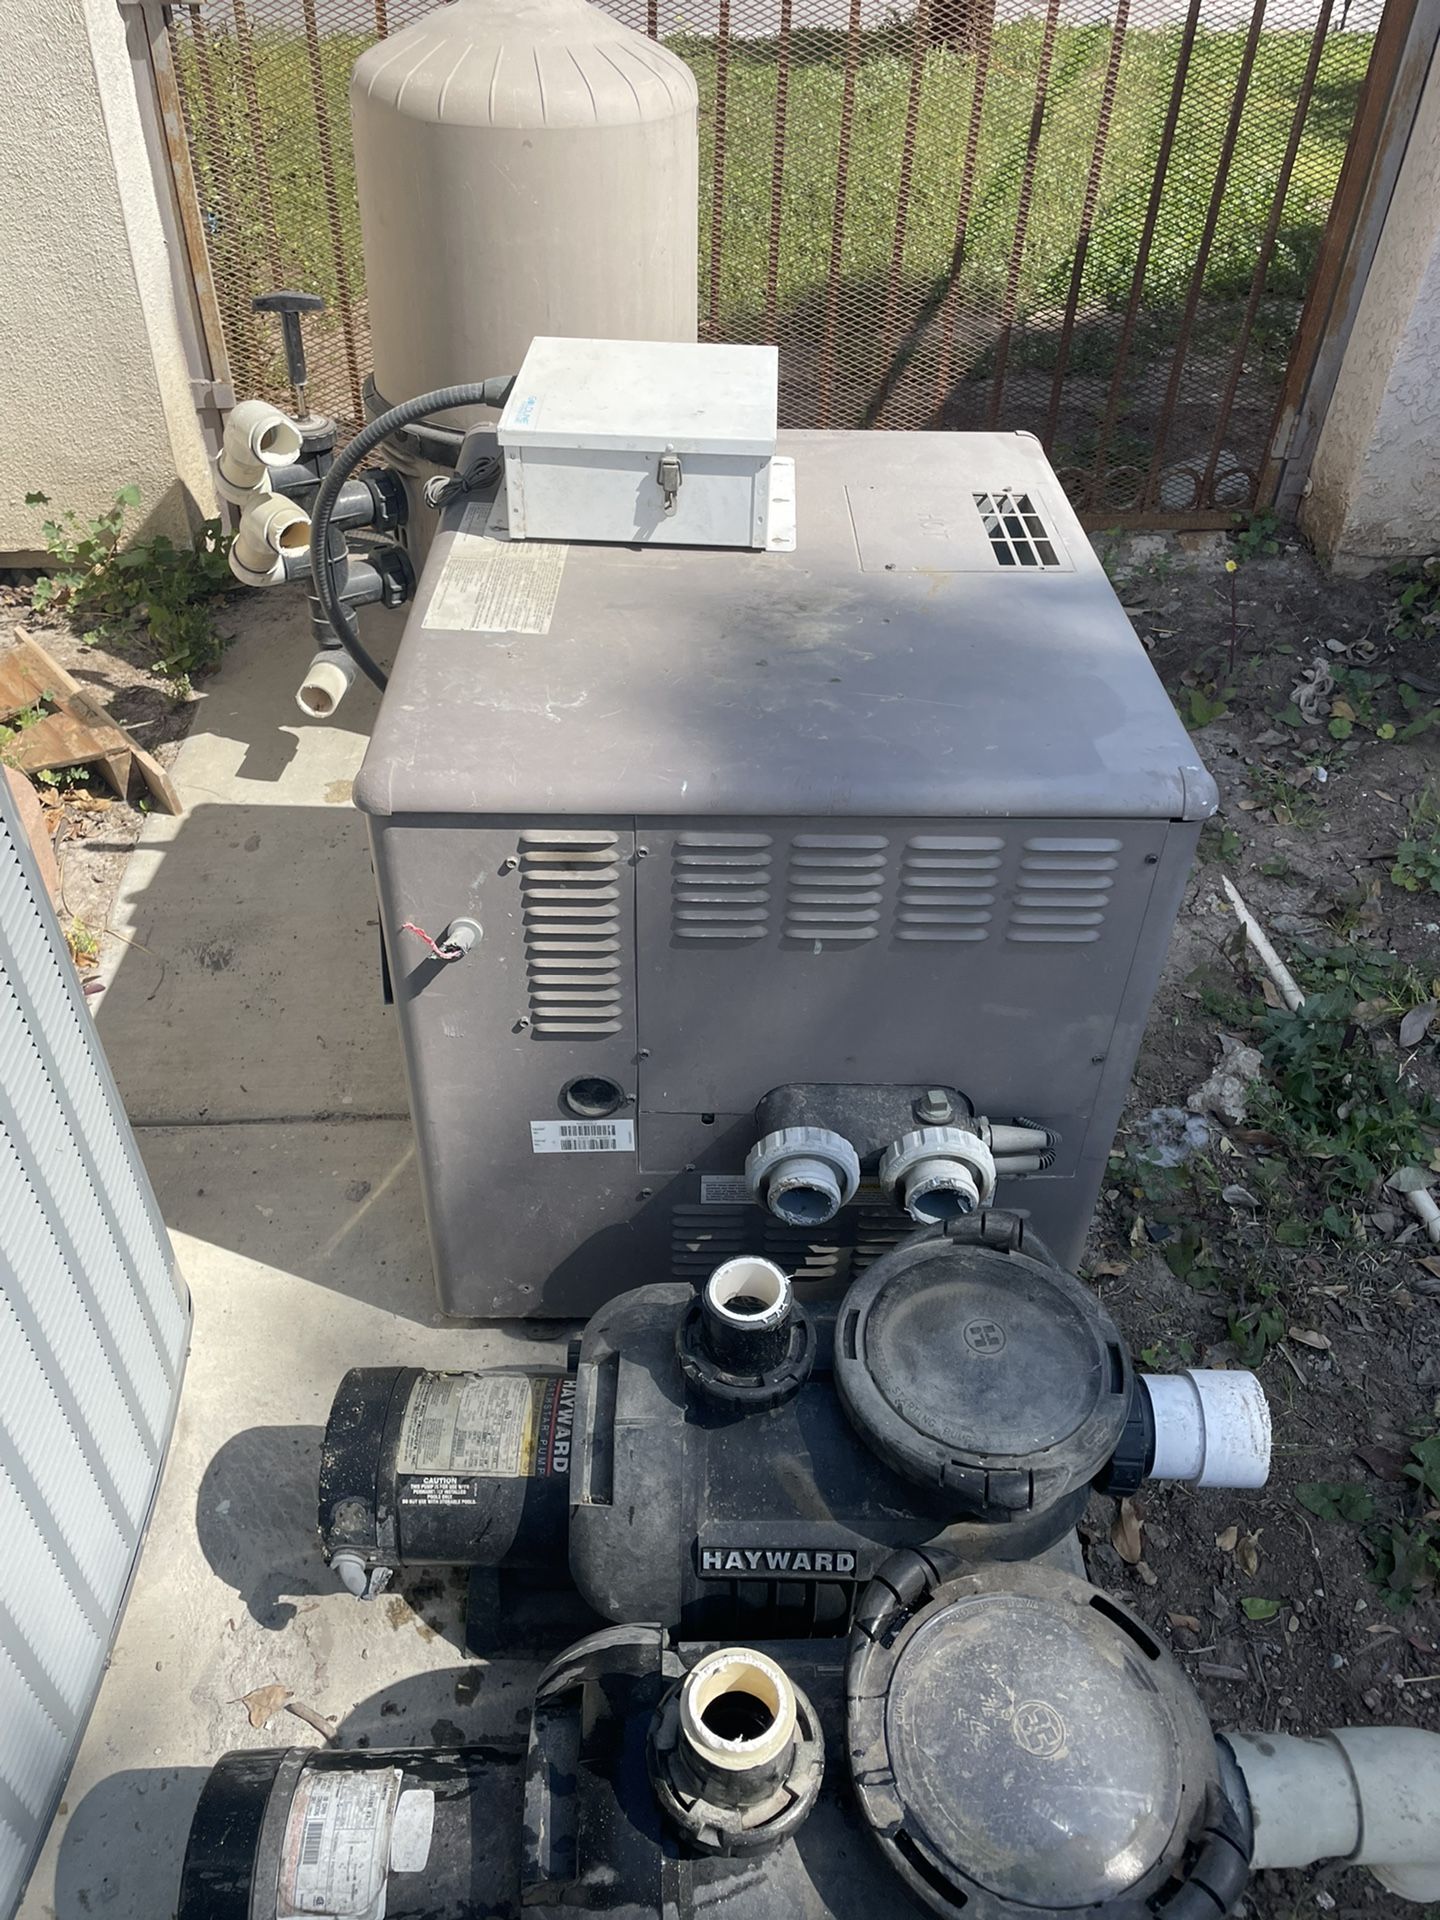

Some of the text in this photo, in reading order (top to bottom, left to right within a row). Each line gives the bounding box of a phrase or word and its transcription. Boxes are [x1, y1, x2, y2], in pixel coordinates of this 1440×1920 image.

[553, 1380, 577, 1473] HAYWARD
[537, 1440, 548, 1475] PUMP
[423, 1477, 457, 1485] CAUTION
[702, 1551, 855, 1572] HAYWARD
